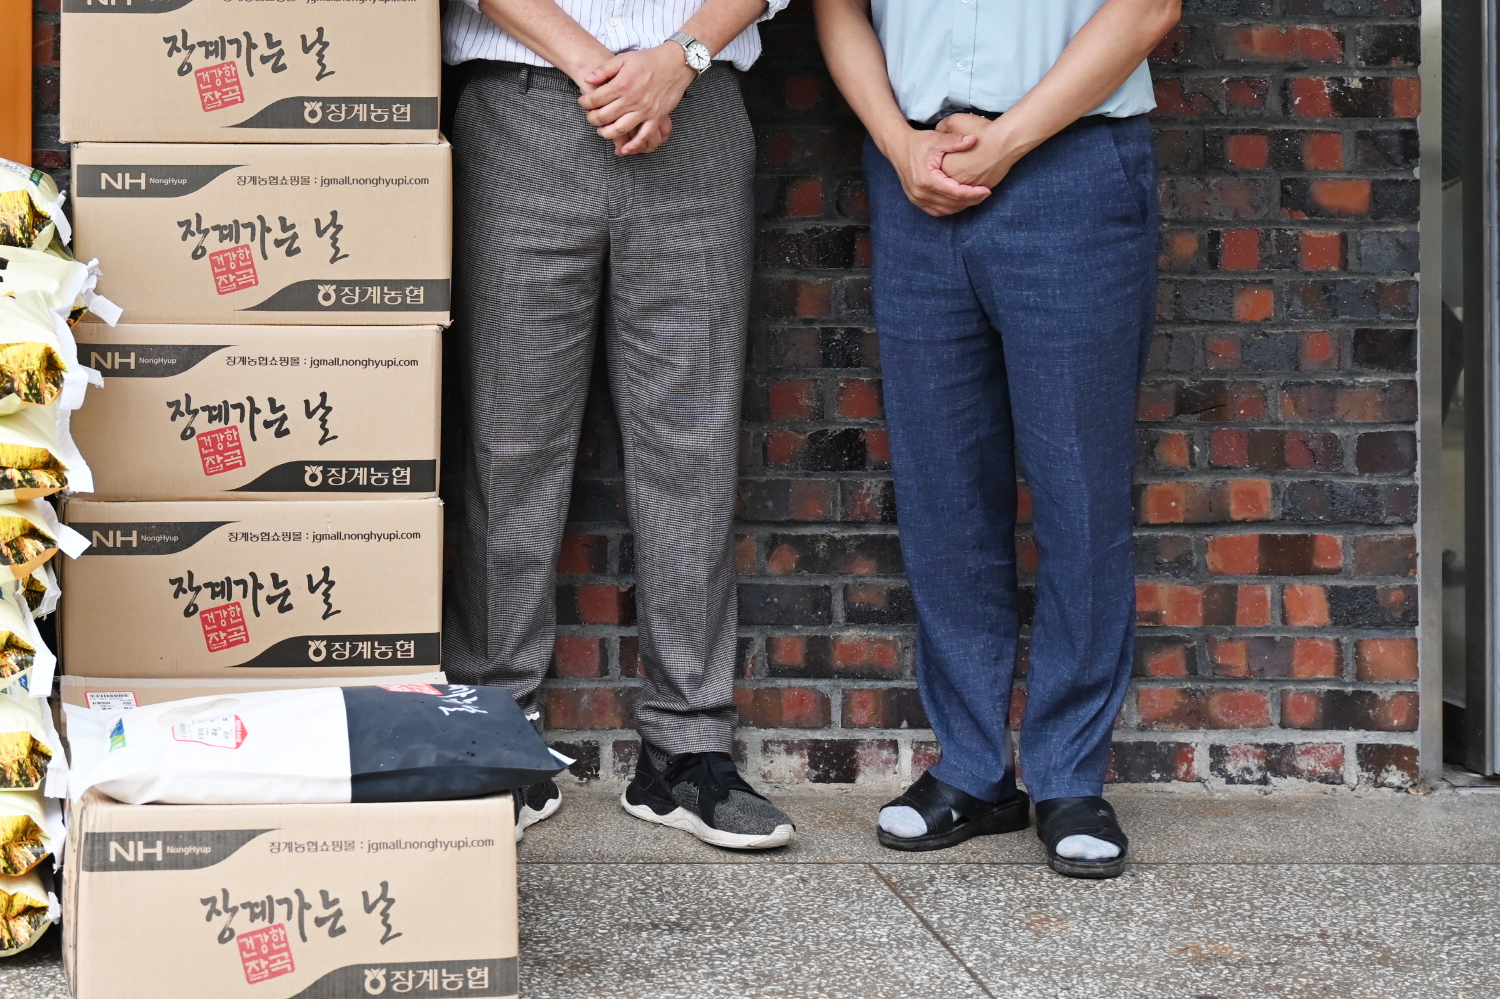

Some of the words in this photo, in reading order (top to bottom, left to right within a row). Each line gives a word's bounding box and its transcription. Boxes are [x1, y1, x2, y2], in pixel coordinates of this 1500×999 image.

[163, 29, 287, 77] 장계가는
[301, 27, 335, 81] 날
[197, 64, 237, 89] 건강한
[326, 103, 411, 123] 장계농협
[101, 173, 146, 190] NH
[236, 176, 310, 186] 장계농협쇼핑몰
[320, 175, 429, 188] jgmall.nonghyupi.com
[177, 212, 301, 260] 장계가는
[314, 210, 349, 264] 날
[211, 247, 251, 272] 건강한
[340, 285, 424, 304] 장계농협
[90, 352, 135, 369] NH
[139, 357, 176, 365] NongHyup
[226, 356, 300, 366] 장계농협쇼핑몰
[310, 356, 419, 368] jgmall.nonghyupi.com
[166, 393, 290, 441] 장계가는
[304, 391, 338, 445] 날
[199, 428, 239, 453] 건강한
[326, 467, 410, 486] 장계농협
[92, 530, 137, 547] NH
[227, 531, 302, 542] 장계농협쇼핑몰
[312, 530, 421, 542] jgmall.nonghyupi.com
[169, 570, 293, 618] 장계가는
[306, 566, 341, 620] 날
[202, 605, 242, 630] 건강한
[331, 641, 414, 660] 장계농협
[110, 841, 162, 862] NH
[166, 846, 211, 855] NongHyup
[269, 840, 354, 853] 장계농협쇼핑몰
[367, 837, 494, 854] jgmall.nonghyupi.com
[200, 888, 347, 944] 장계가는
[362, 881, 403, 945] 날
[239, 927, 287, 958] 건강한
[390, 966, 489, 992] 장계농협
